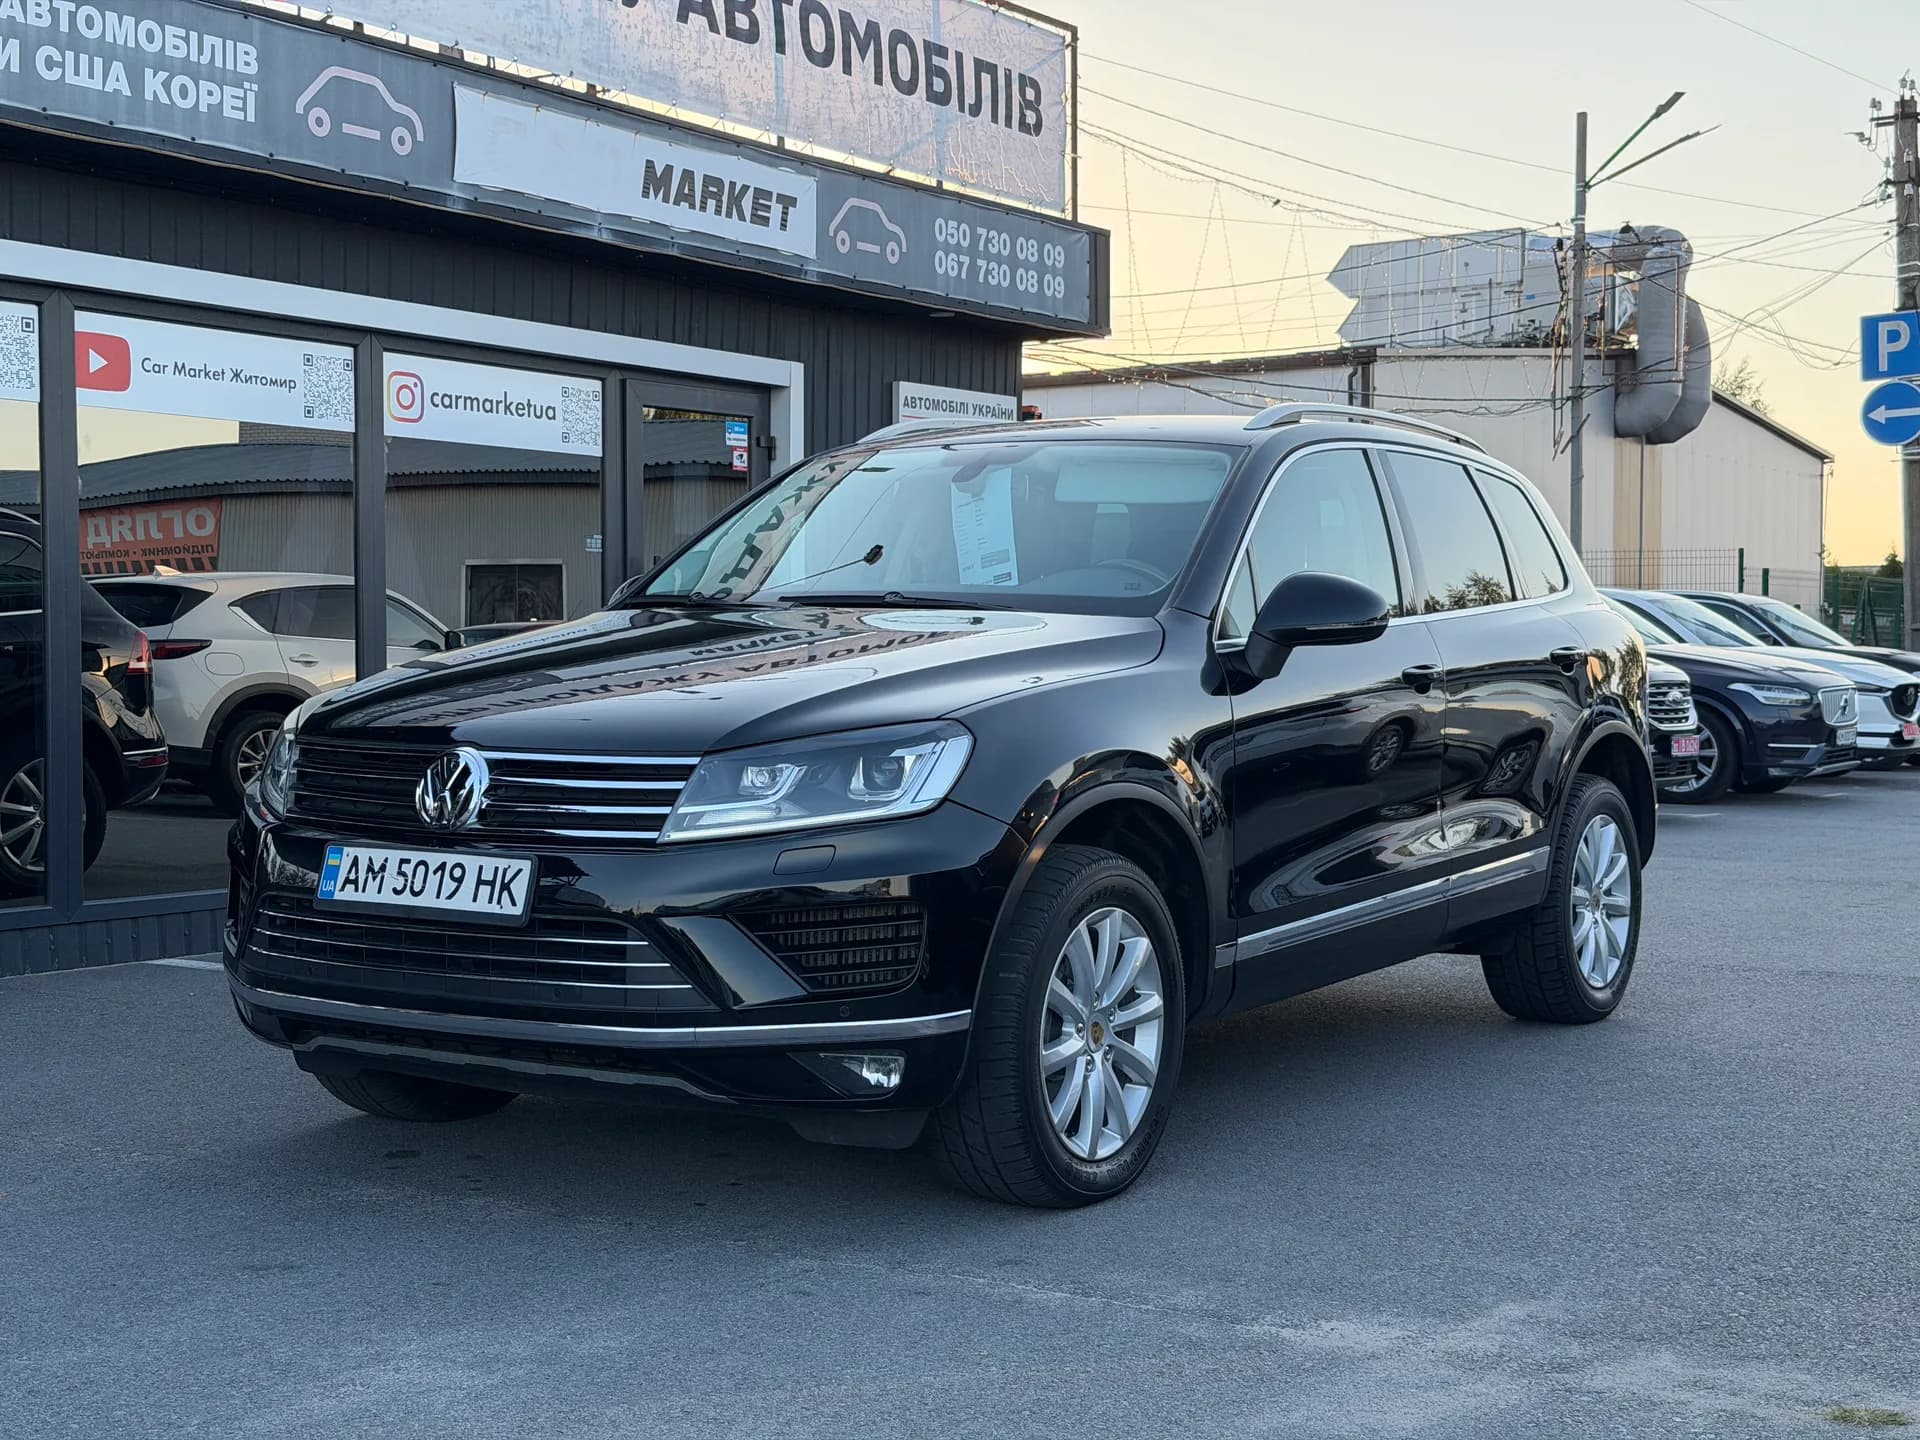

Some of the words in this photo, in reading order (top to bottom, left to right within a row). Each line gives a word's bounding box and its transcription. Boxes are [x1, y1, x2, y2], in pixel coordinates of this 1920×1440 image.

[0, 0, 259, 75] АВТОМОБІЛІВ
[35, 45, 132, 96] США
[144, 67, 258, 122] КОРЕЇ
[642, 159, 798, 232] MARKET
[934, 217, 971, 248] 050
[976, 226, 1011, 256] 730
[1016, 236, 1039, 262] 08
[1043, 243, 1065, 269] 09
[934, 249, 970, 280] 067
[976, 258, 1011, 288] 730
[1016, 267, 1039, 294] 08
[1043, 273, 1065, 299] 09
[1878, 320, 1911, 372] P
[141, 357, 168, 375] Car
[172, 361, 226, 381] Market
[229, 367, 297, 393] Житомир
[430, 391, 556, 420] carmarketua
[902, 395, 969, 415] АВТОМОБІЛІ
[972, 403, 1014, 421] УКРАЇНИ
[322, 879, 335, 892] UA
[339, 854, 389, 895] AM
[392, 858, 467, 901] 5019
[472, 864, 524, 907] HK
